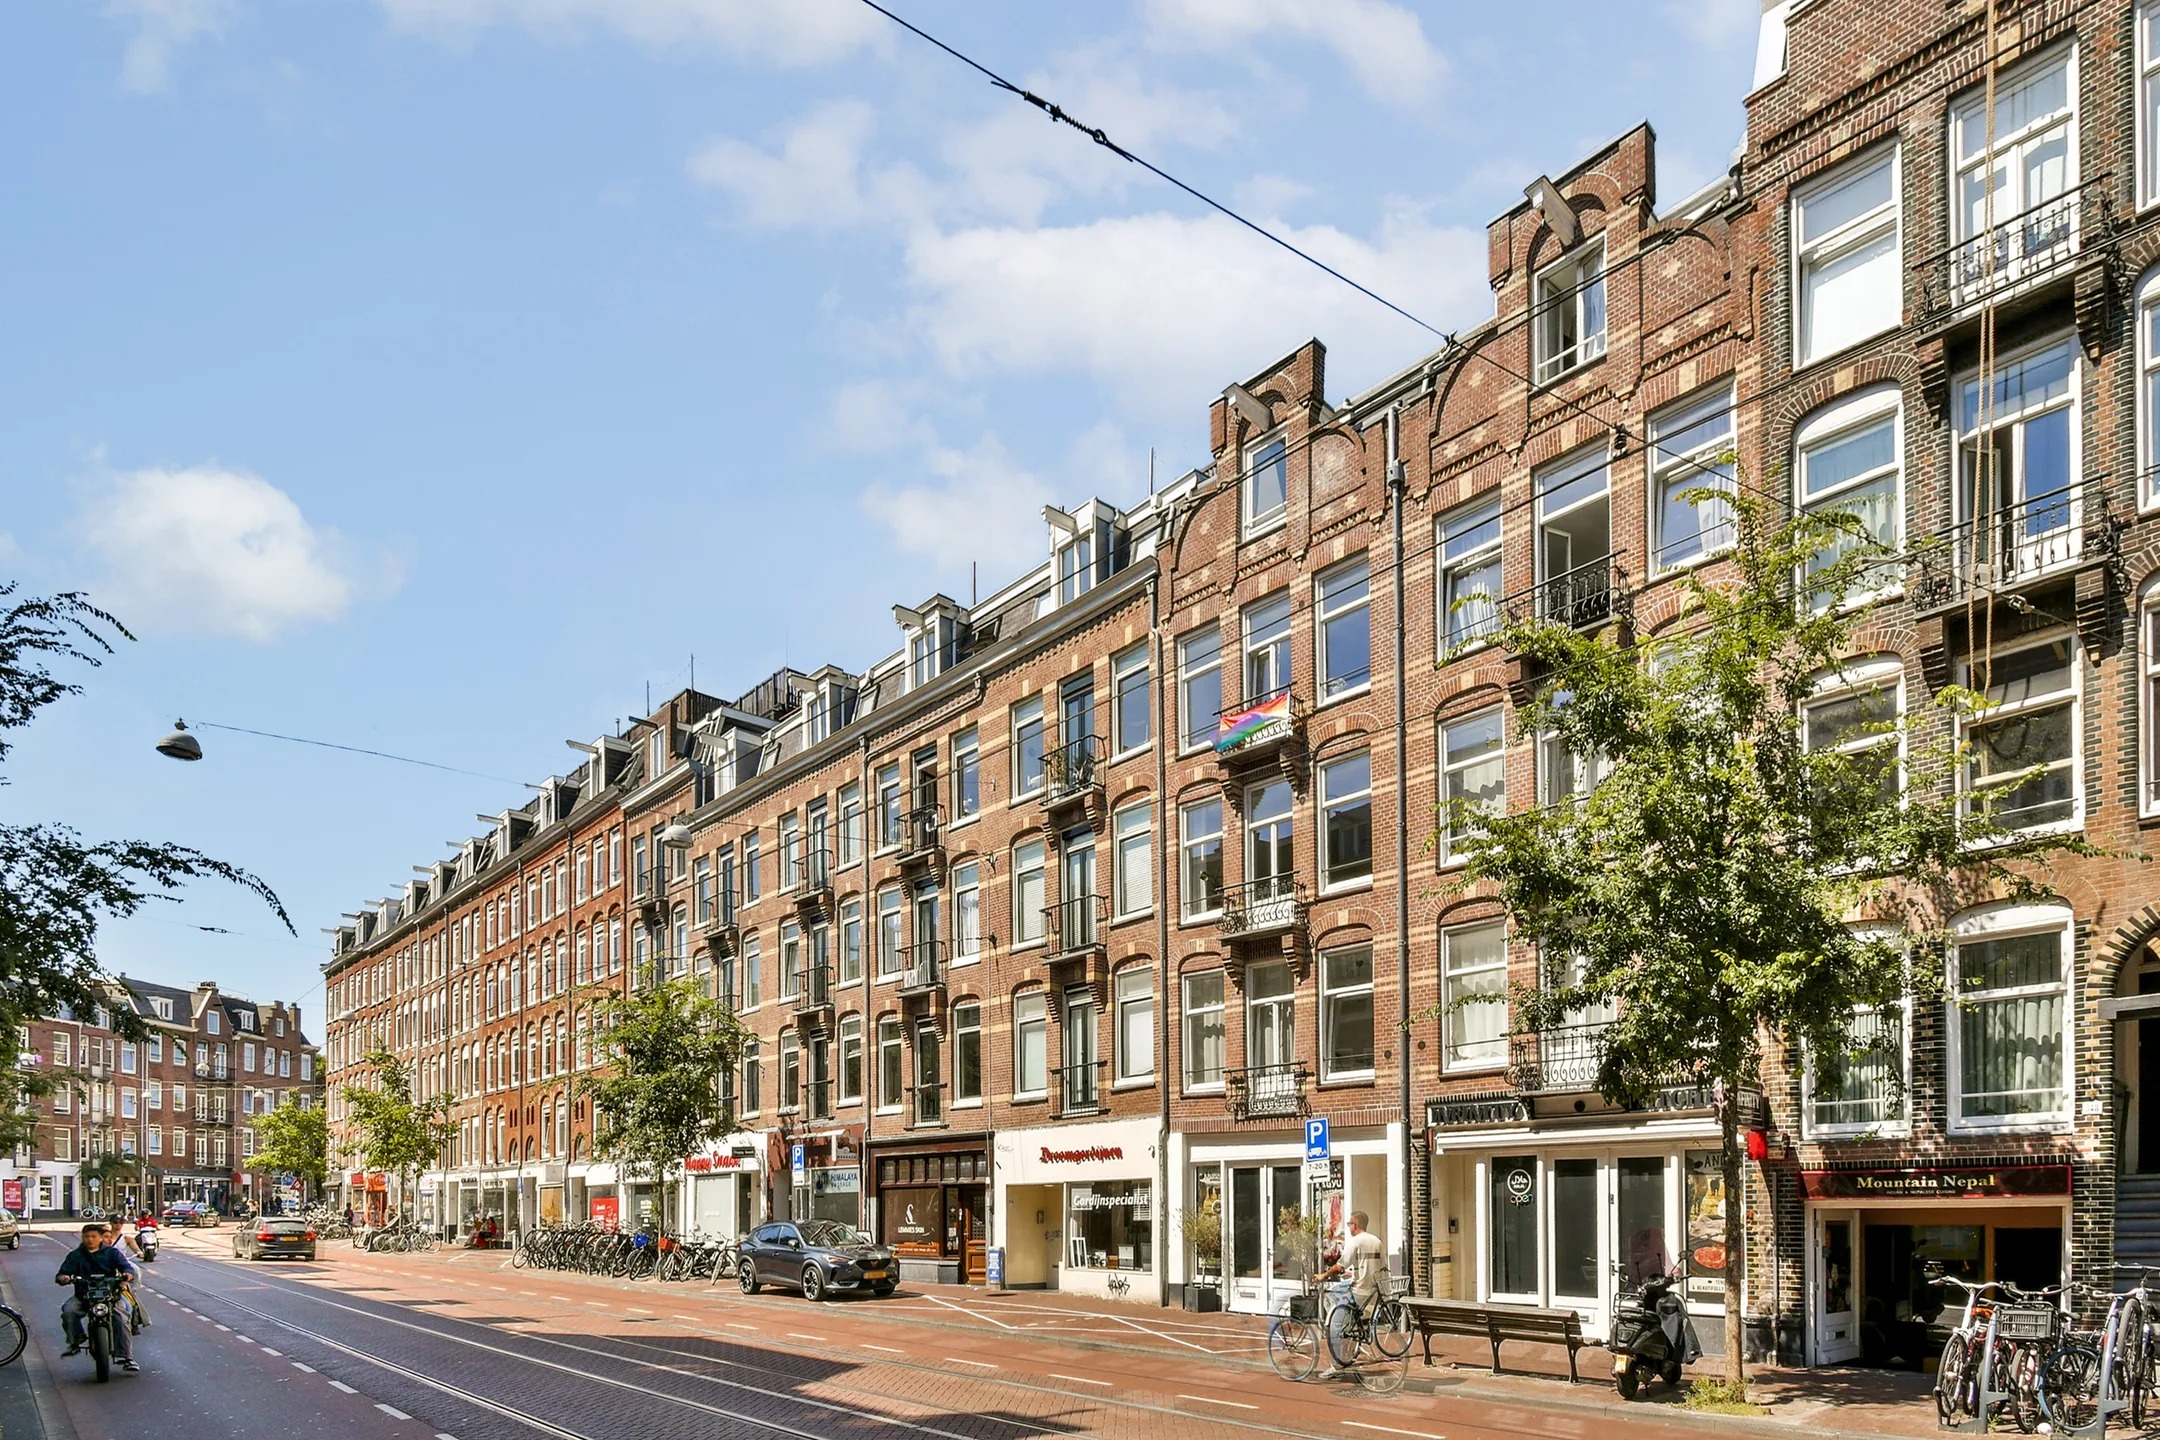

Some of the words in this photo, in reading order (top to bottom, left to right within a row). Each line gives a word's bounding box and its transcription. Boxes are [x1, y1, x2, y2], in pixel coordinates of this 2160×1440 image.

[1310, 1122, 1323, 1144] P
[794, 1147, 801, 1162] P
[830, 1172, 858, 1181] HIMALAYA
[1857, 1176, 1938, 1188] Mountain
[1943, 1174, 1996, 1190] Nepal
[1073, 1192, 1149, 1209] Gordijnspecialist
[1510, 1194, 1534, 1207] open
